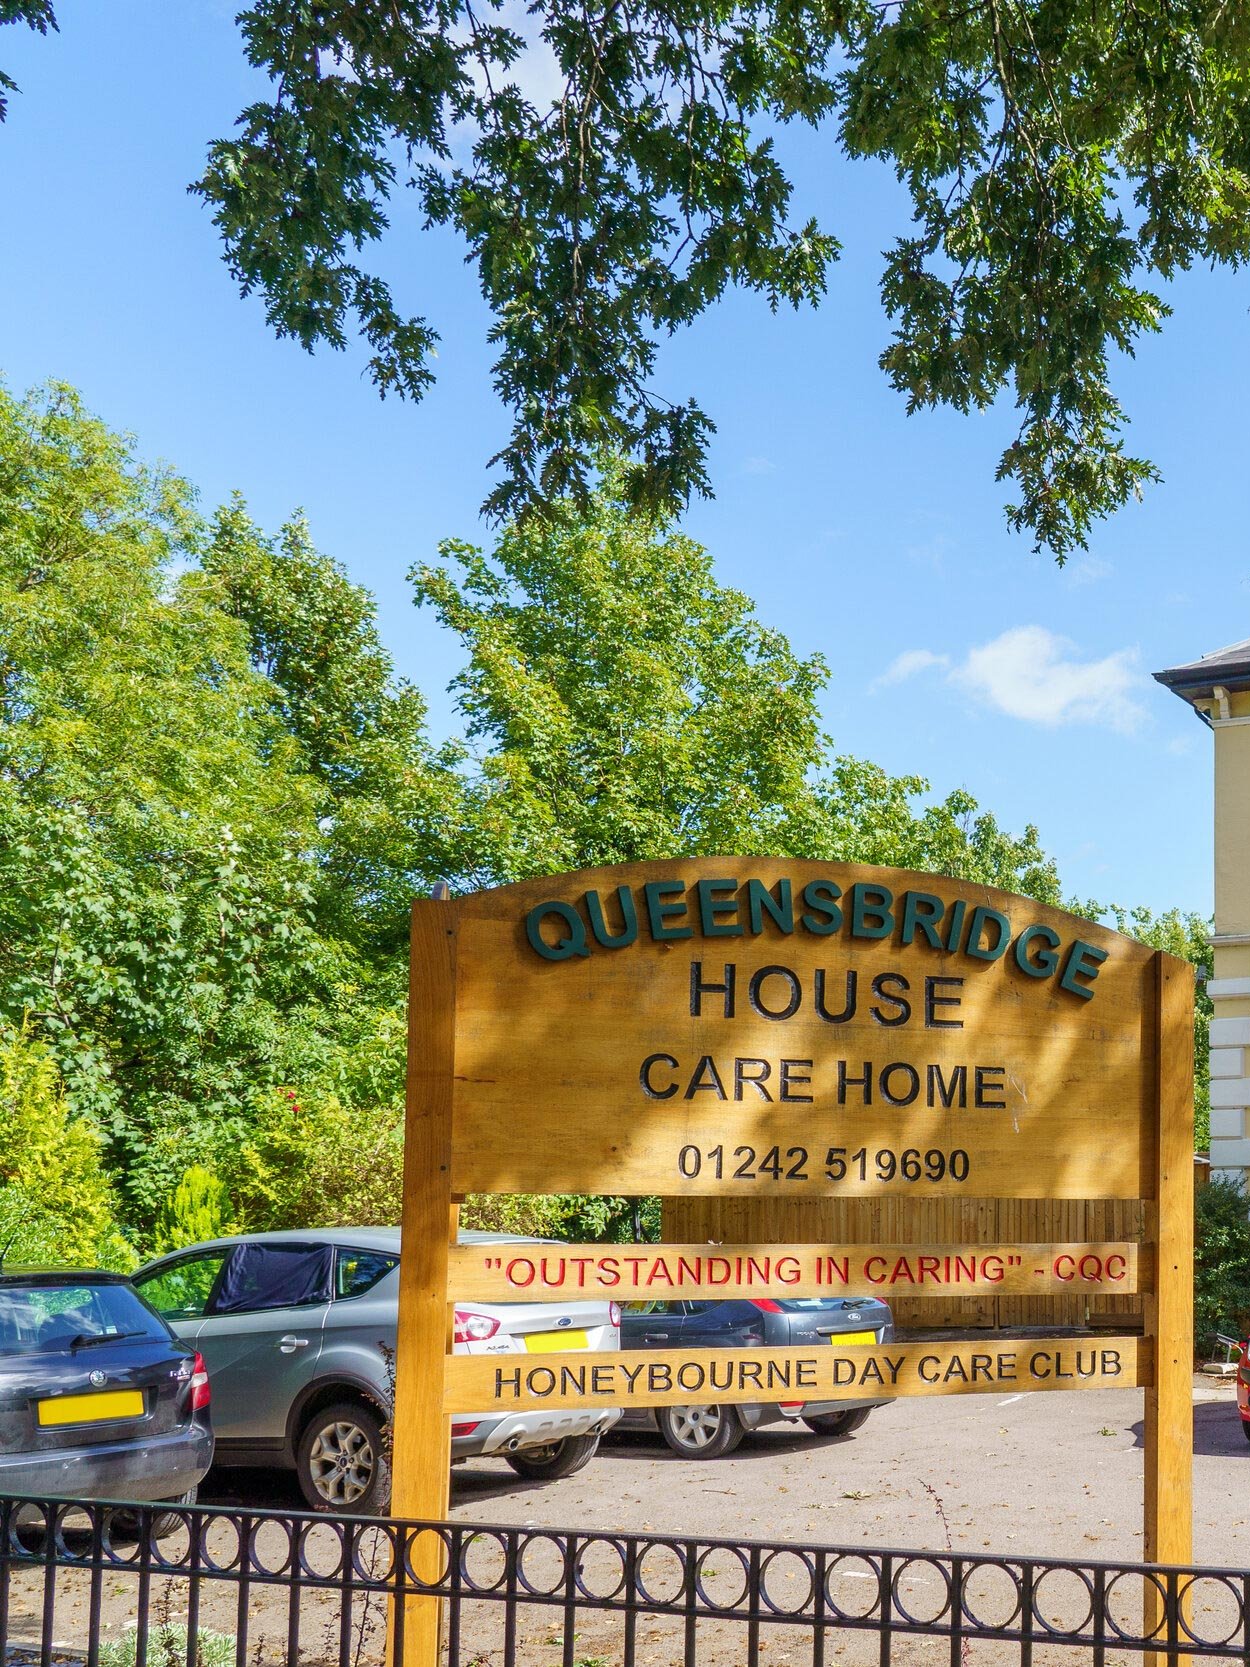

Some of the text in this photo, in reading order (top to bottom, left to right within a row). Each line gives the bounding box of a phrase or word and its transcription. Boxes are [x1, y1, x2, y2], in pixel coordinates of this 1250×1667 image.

[525, 877, 1110, 1000] QUEENSBRIDGE
[689, 961, 965, 1029] HOUSE
[639, 1052, 1006, 1109] CARE HOME
[678, 1144, 970, 1183] 01242 519690
[485, 1256, 801, 1288] "OUTSTANDING
[815, 1256, 849, 1285] IN
[863, 1255, 1022, 1285] CARING"
[1053, 1254, 1127, 1283] CQC
[494, 1350, 1122, 1399] HONEYBOURNE DAY CARE CLUB
